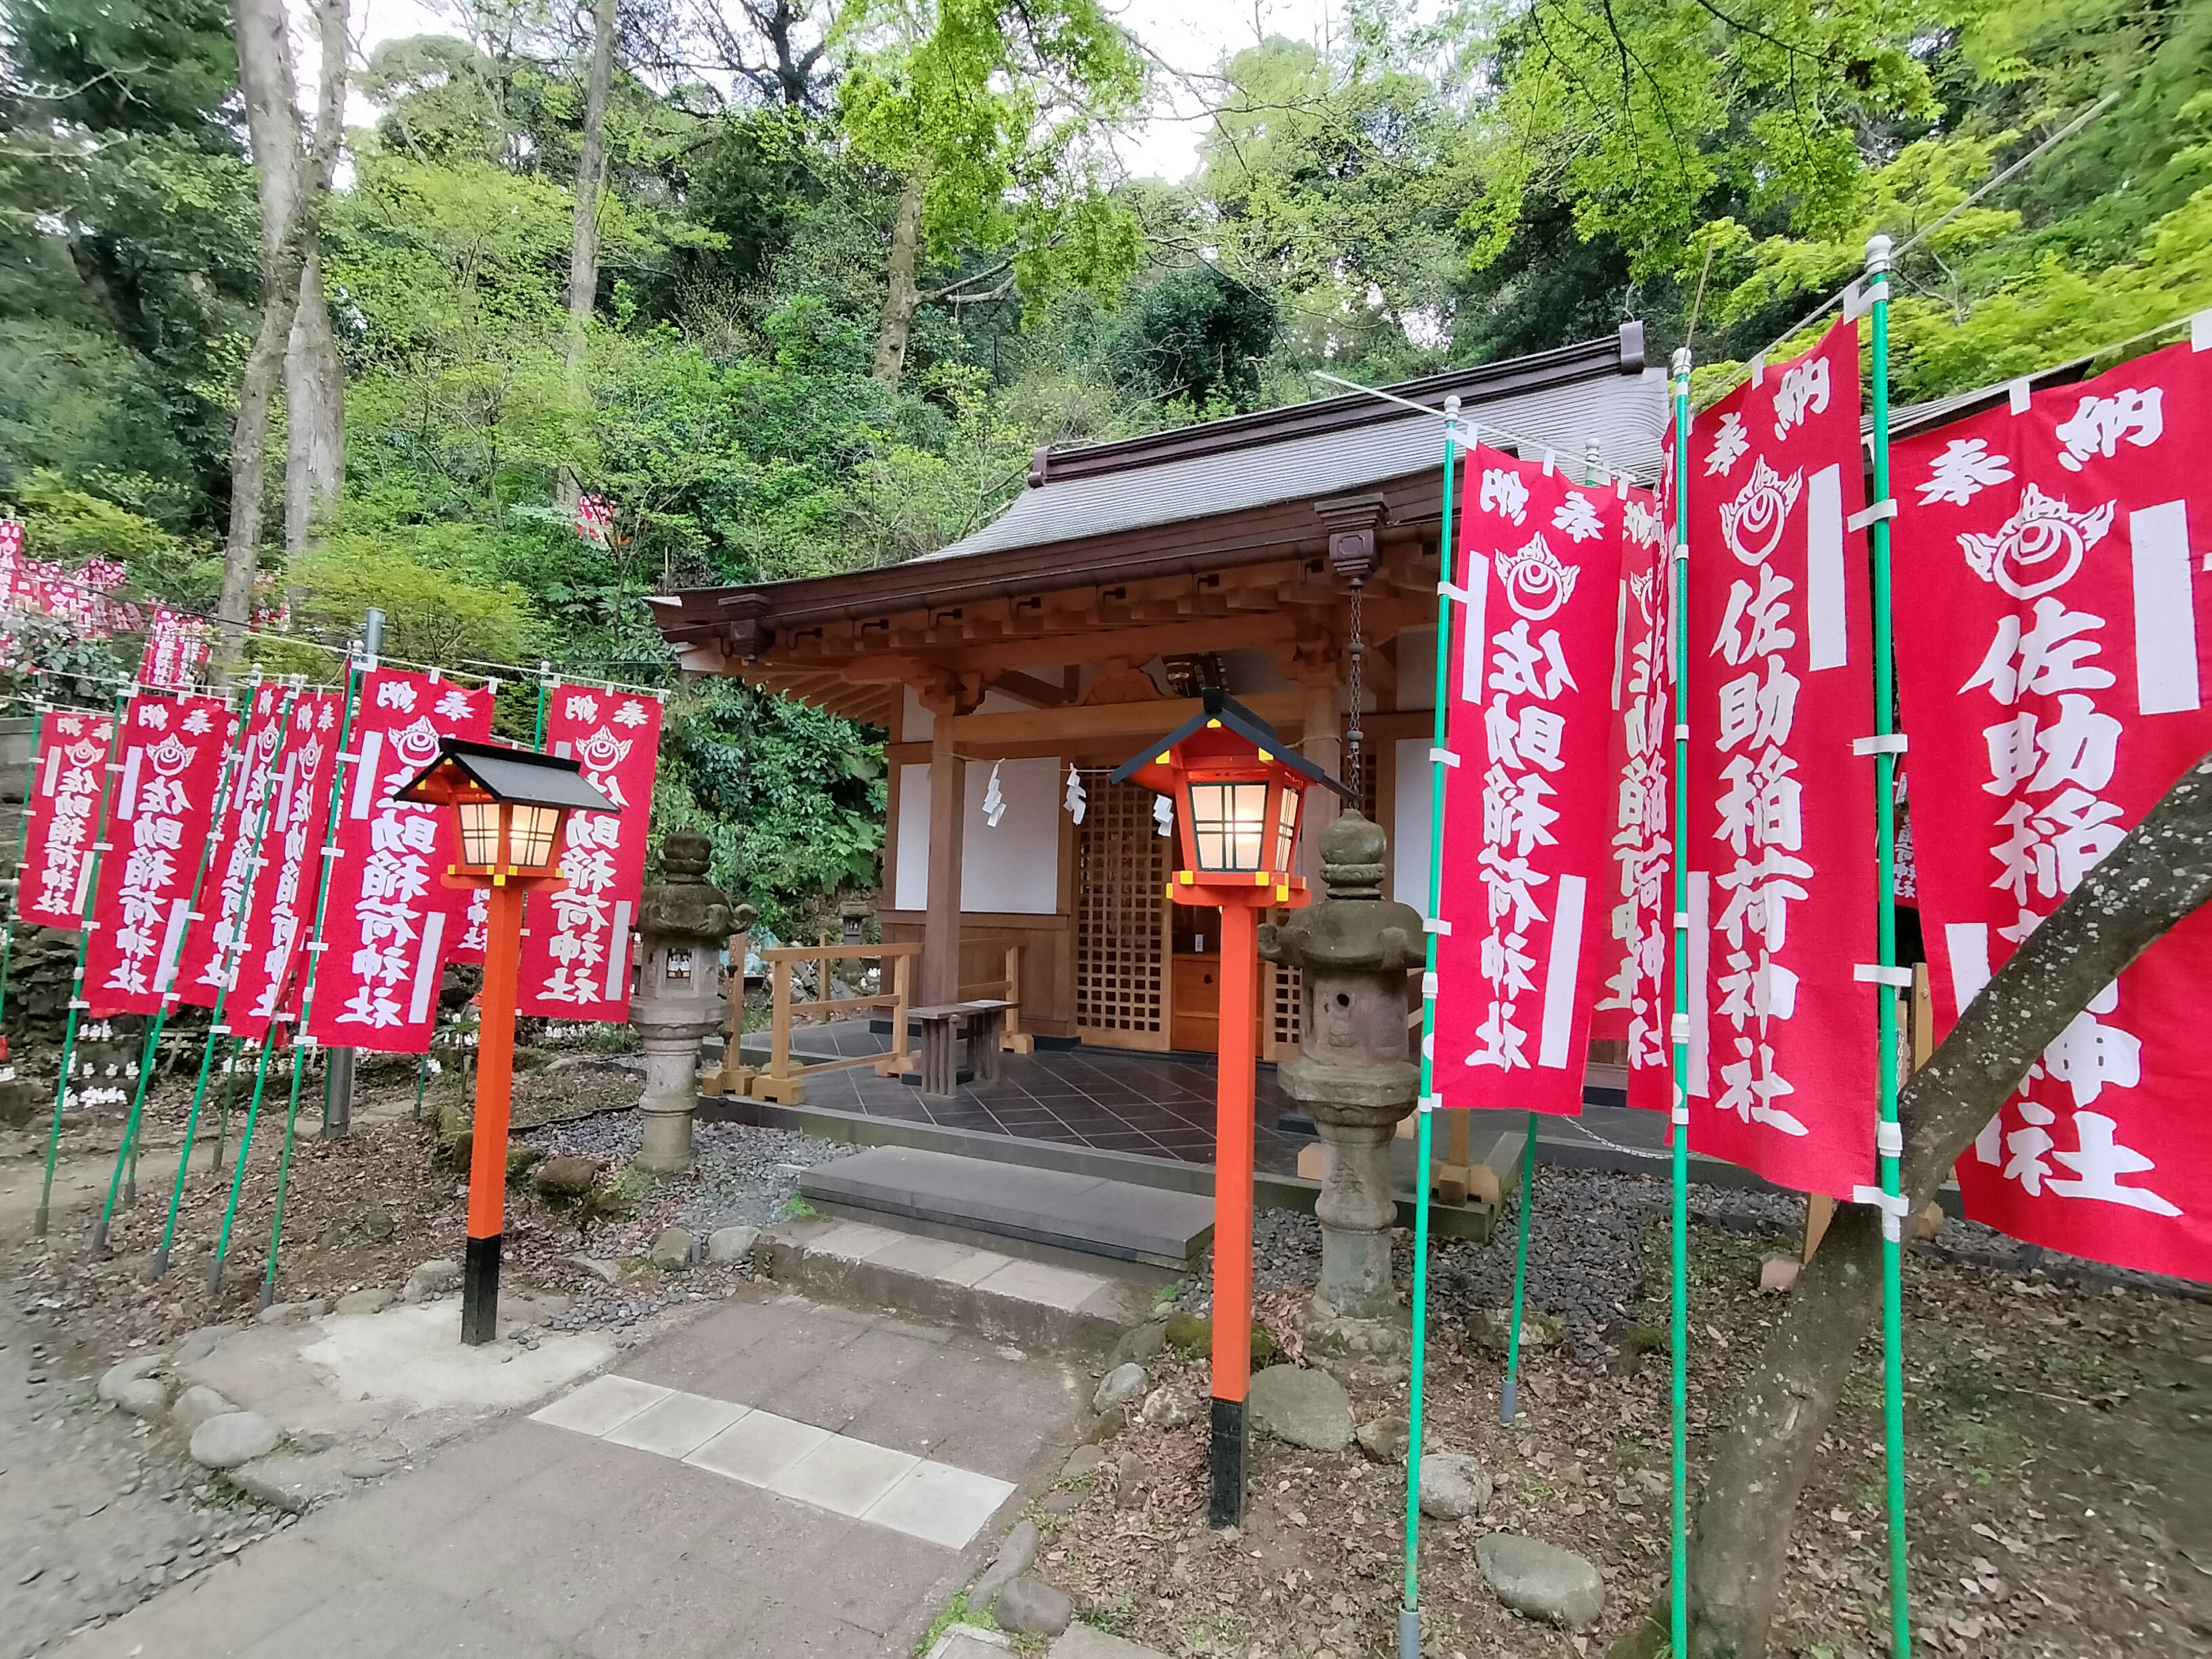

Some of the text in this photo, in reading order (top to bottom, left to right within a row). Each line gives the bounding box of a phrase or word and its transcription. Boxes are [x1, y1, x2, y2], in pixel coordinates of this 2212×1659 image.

[1703, 355, 1831, 478] 奉納
[1915, 386, 2164, 506] 奉納
[1709, 562, 1813, 1136] 佐助稲荷神社
[1956, 597, 2184, 1218] 佐助稲神社
